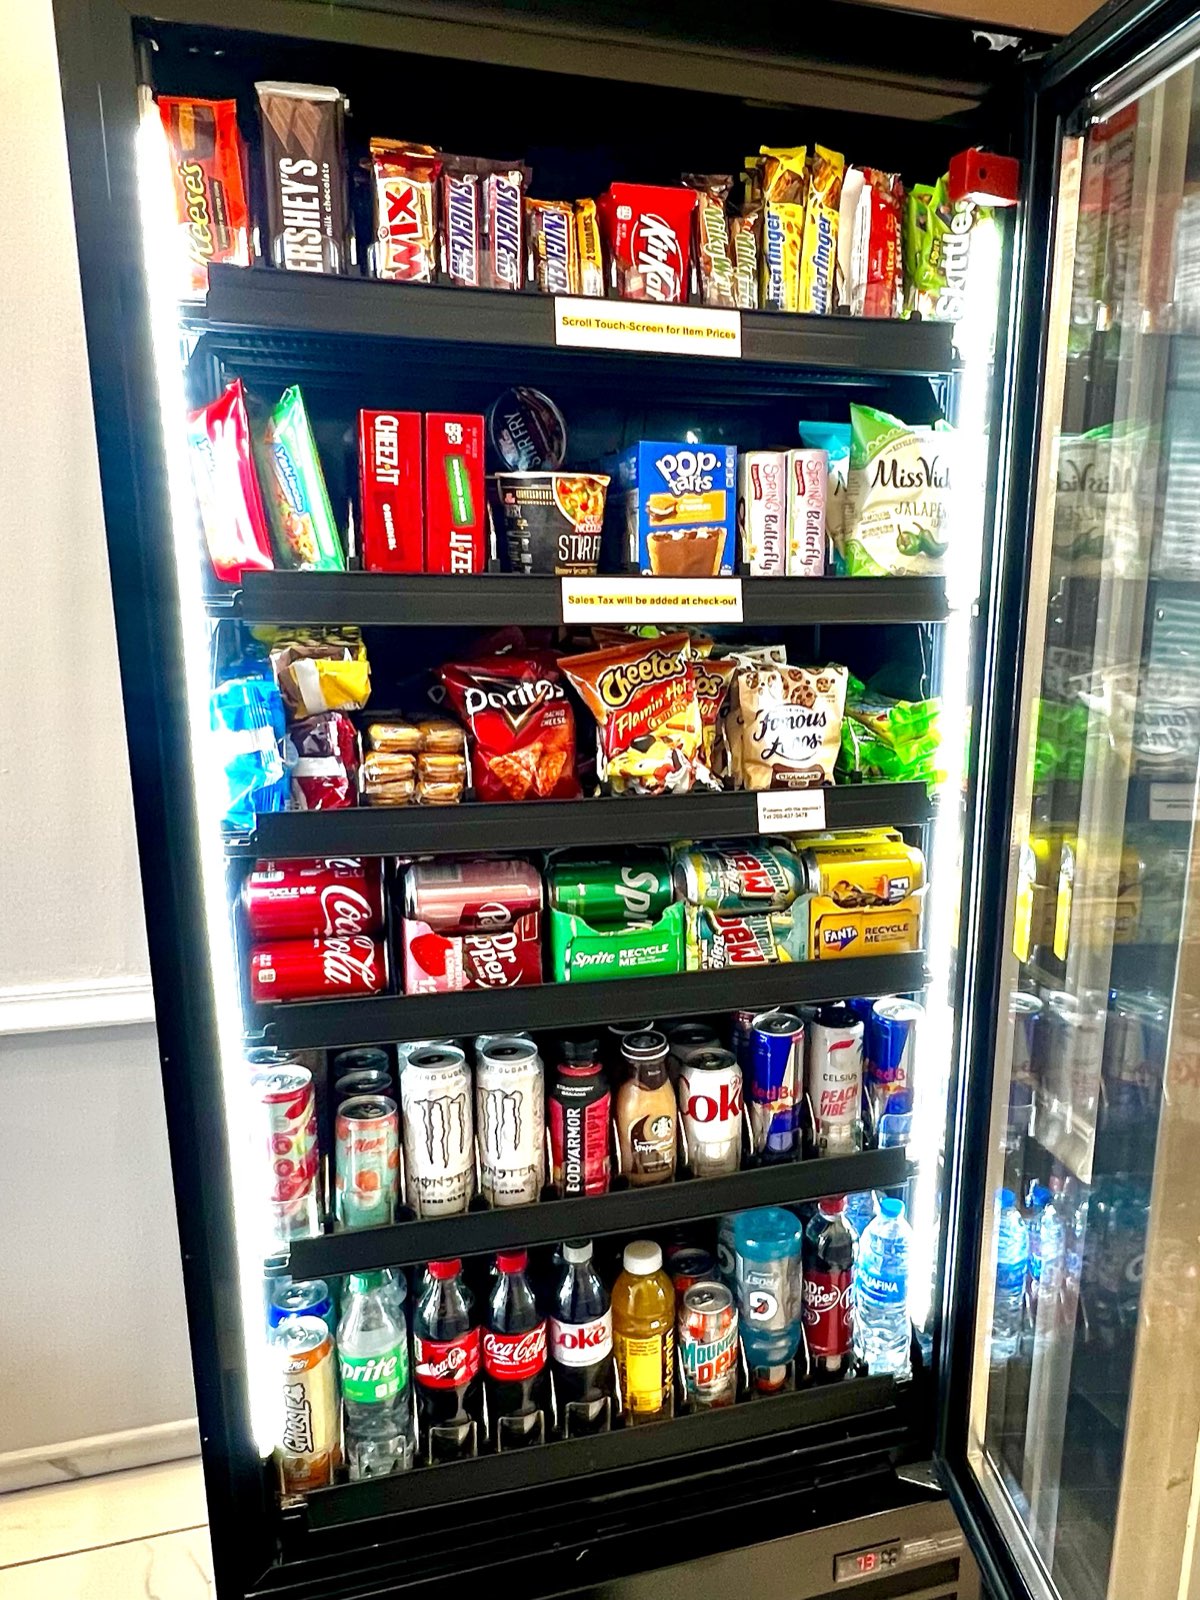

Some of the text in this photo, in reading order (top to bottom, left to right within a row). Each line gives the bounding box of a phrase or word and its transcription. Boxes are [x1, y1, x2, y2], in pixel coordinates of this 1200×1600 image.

[323, 162, 333, 237] milk chocolate
[279, 157, 324, 274] ERSHEY'S
[385, 187, 425, 282] WIX
[562, 316, 736, 340] Scroll Touch-Screen for Item Prices
[504, 411, 528, 438] FRY
[568, 595, 737, 606] Sales Tax will be added at check-out
[600, 651, 685, 707] Cheetos
[464, 679, 564, 716] Doritos
[824, 926, 858, 943] FANTA
[865, 923, 909, 936] RECYCLE
[865, 933, 880, 943] ME
[464, 934, 508, 985] pper
[491, 932, 518, 964] Dr
[573, 951, 616, 968] Sprite
[619, 943, 669, 958] RECYCLE
[619, 957, 637, 968] ME
[823, 1073, 857, 1082] CELSIUS
[821, 1084, 858, 1103] PEACH
[820, 1102, 847, 1116] VIBE
[566, 1107, 581, 1193] BODYARMOR
[342, 1355, 398, 1382] prite
